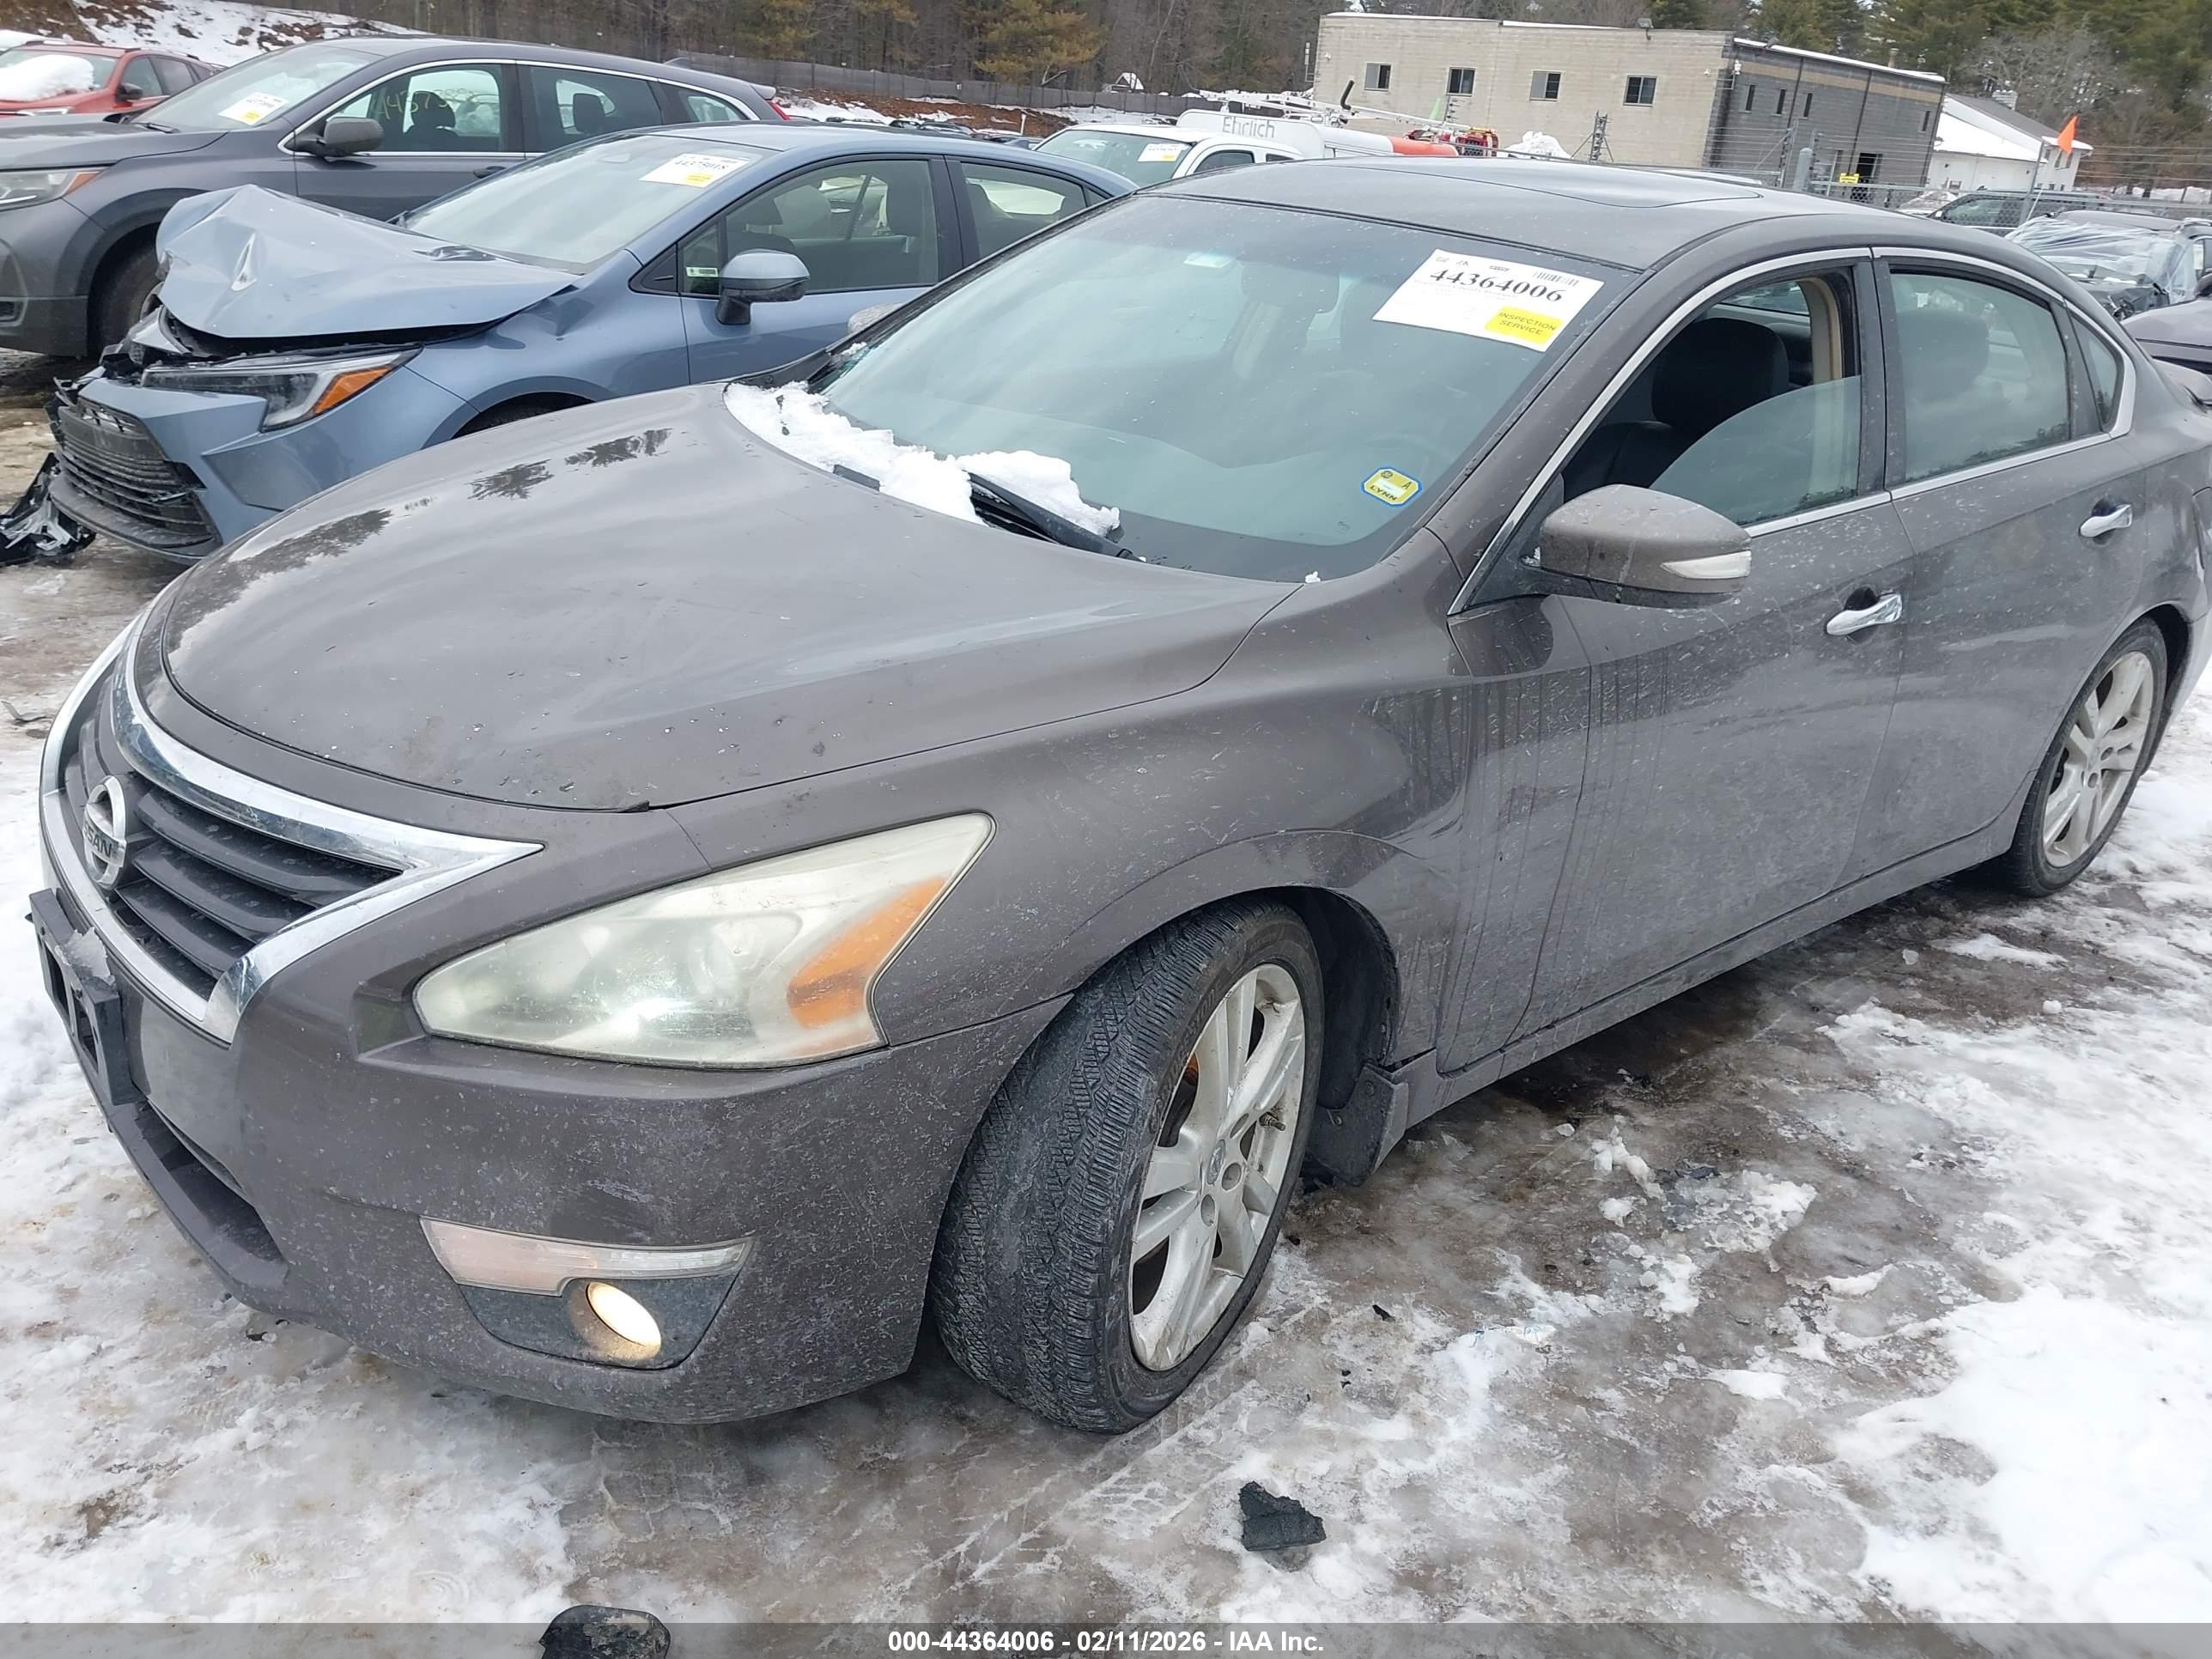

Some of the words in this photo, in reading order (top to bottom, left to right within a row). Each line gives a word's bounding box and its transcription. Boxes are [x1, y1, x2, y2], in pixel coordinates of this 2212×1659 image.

[1222, 116, 1275, 138] Ehrlich
[1430, 268, 1567, 302] 44364006
[1498, 312, 1557, 331] INSPECTION
[1499, 319, 1544, 336] SERVICE
